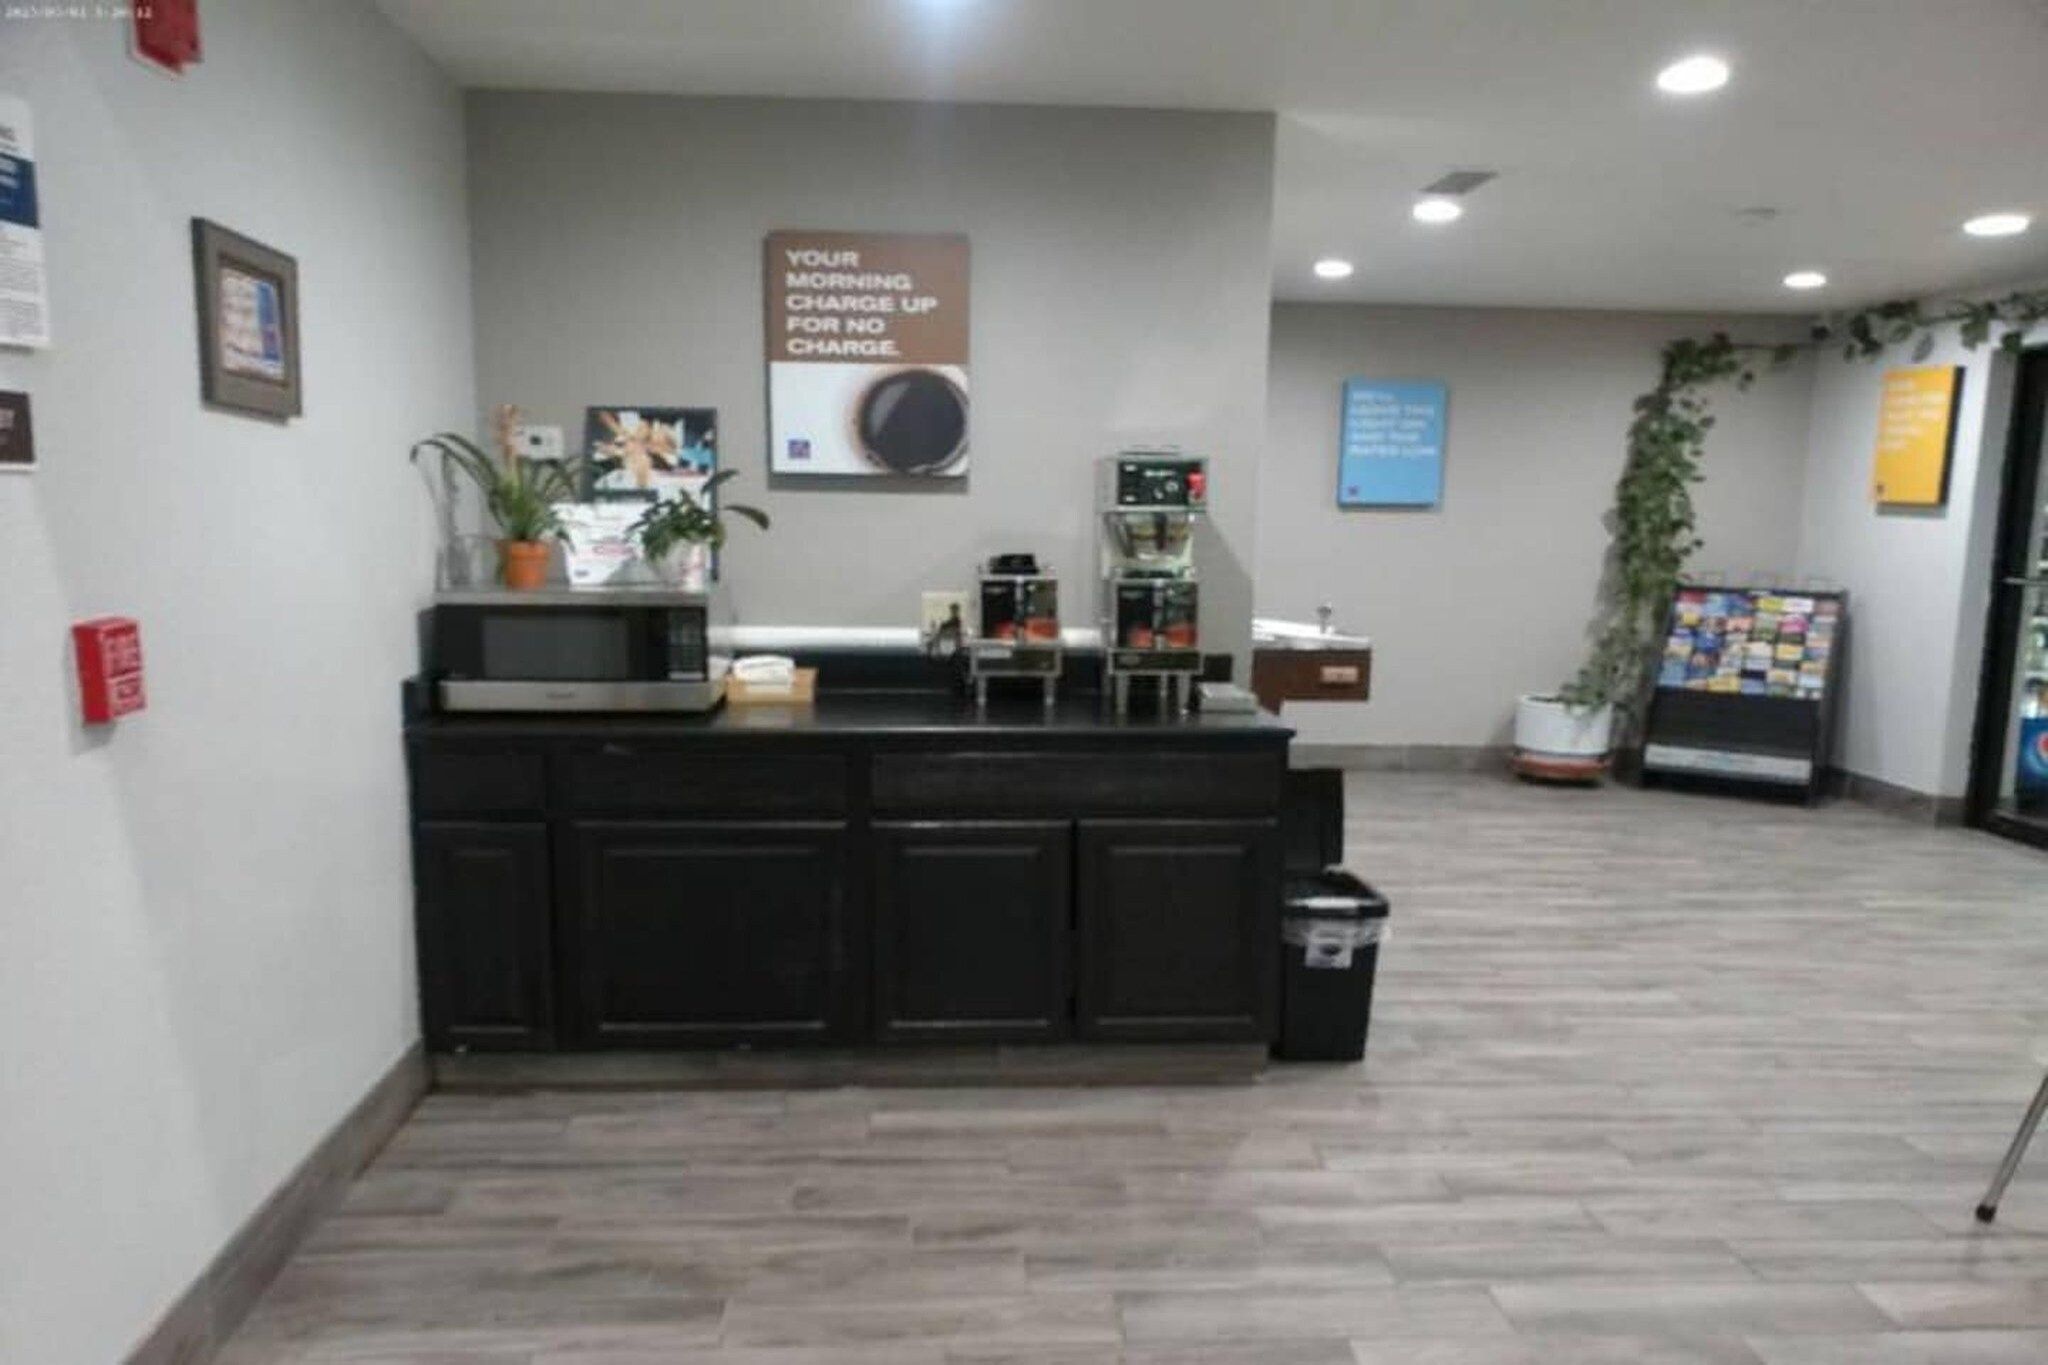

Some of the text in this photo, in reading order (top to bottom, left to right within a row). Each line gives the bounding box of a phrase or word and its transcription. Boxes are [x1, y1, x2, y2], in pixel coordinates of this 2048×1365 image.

[786, 250, 858, 267] YOUR
[786, 272, 911, 290] MORNING
[786, 294, 938, 312] CHARGE UP
[786, 316, 885, 334] FOR NO
[786, 338, 900, 356] CHARGE.
